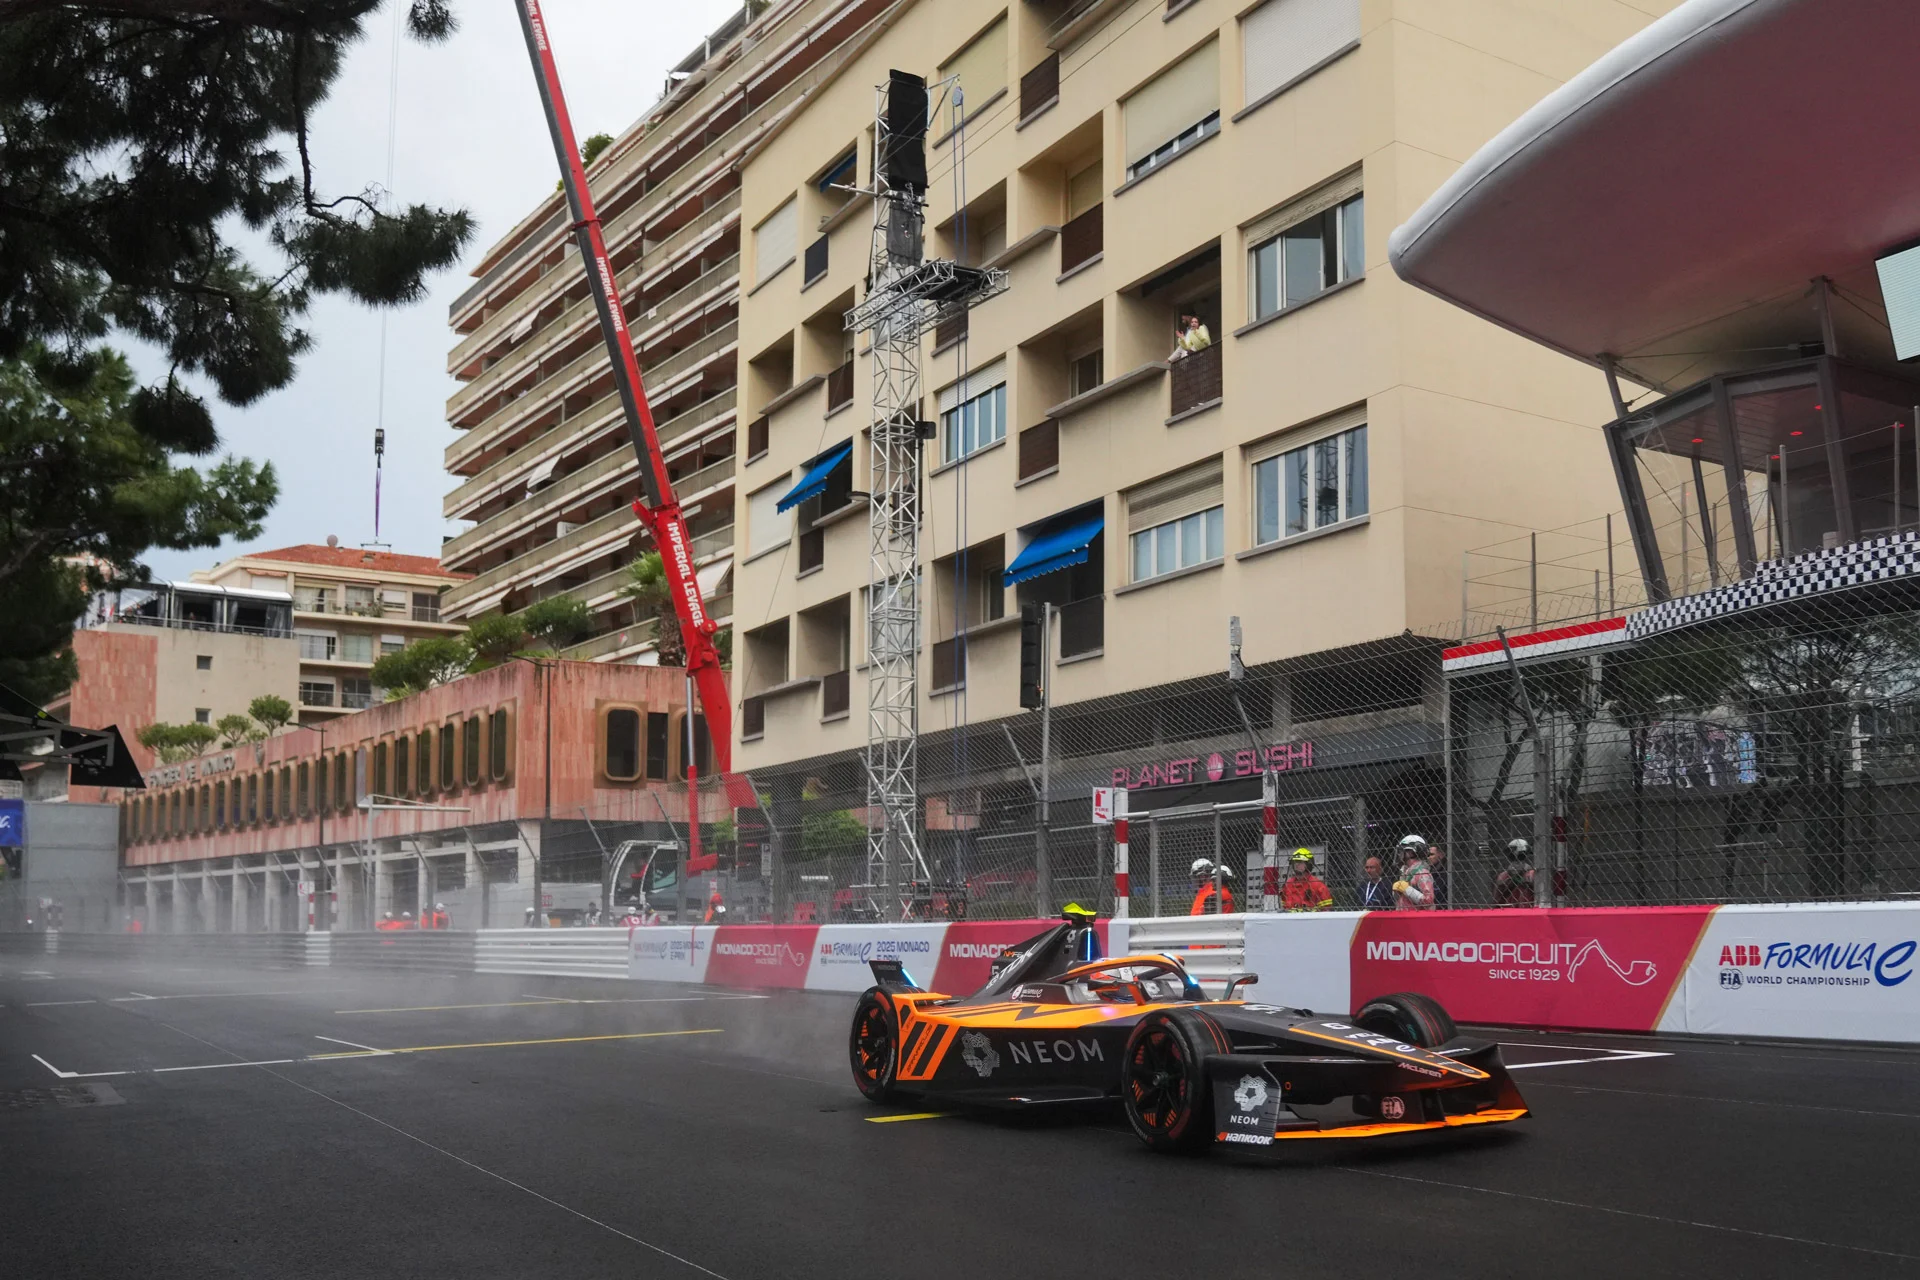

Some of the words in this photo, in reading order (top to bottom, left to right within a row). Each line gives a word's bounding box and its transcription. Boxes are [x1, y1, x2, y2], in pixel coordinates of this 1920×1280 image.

[531, 18, 548, 51] LEVAGE
[596, 257, 614, 297] IMPERIAL
[608, 300, 624, 332] LEVAGE
[667, 522, 691, 579] IMPERIAL
[683, 581, 704, 628] LEVAGE
[1111, 757, 1199, 790] PLANET
[1235, 742, 1313, 776] SUSHI
[820, 943, 832, 955] ABB
[833, 942, 862, 958] FORMULA
[876, 941, 896, 952] 2025
[896, 941, 930, 953] MONACO
[1718, 945, 1761, 966] ABB
[1764, 942, 1877, 971] FORMULA
[1488, 969, 1526, 980] SINCE
[1529, 969, 1560, 981] 1929
[1747, 976, 1782, 985] WORLD
[1787, 976, 1870, 986] CHAMPIONSHIP
[1008, 1038, 1105, 1065] NEOM
[1398, 1062, 1442, 1078] McLaren
[1230, 1114, 1259, 1126] NEOM
